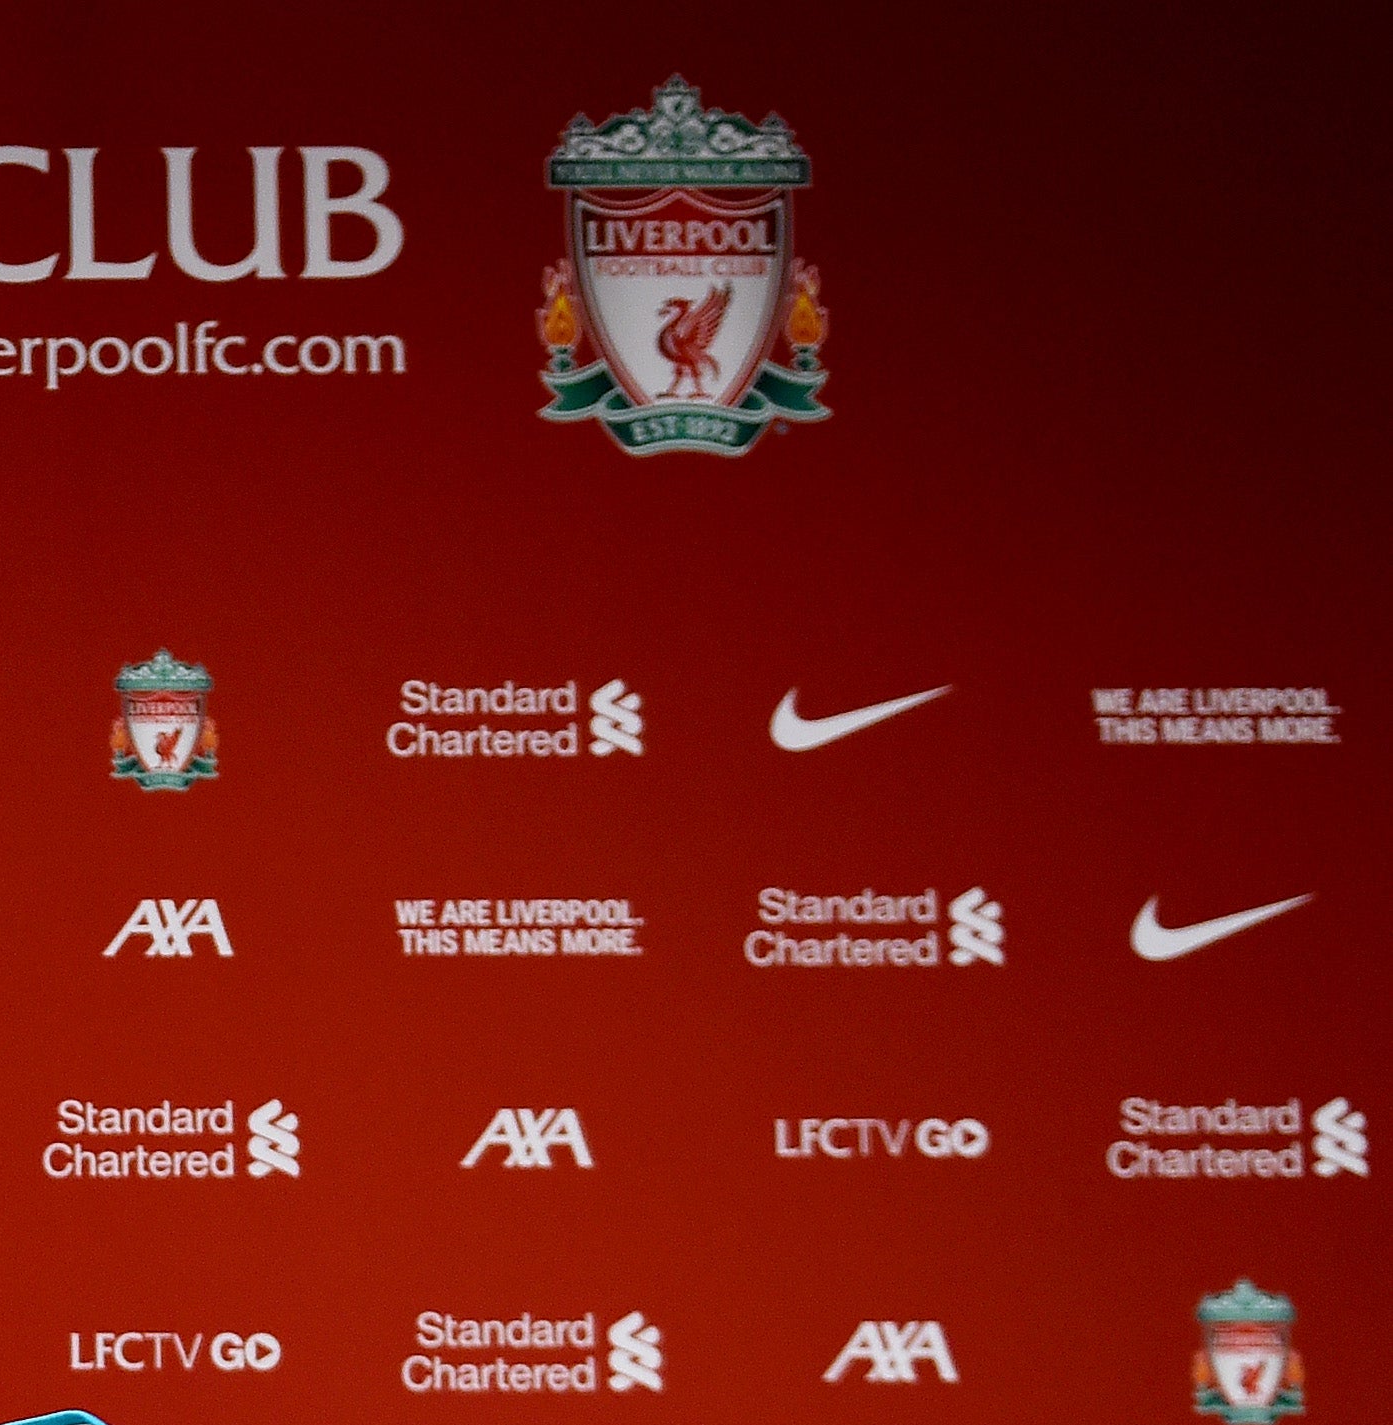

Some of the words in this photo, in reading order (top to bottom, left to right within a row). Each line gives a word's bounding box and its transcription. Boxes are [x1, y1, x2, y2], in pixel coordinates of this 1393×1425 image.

[585, 220, 776, 251] LIVERPOOL
[401, 680, 577, 715] Standard
[386, 722, 578, 757] Chartered
[759, 888, 938, 924] Standard
[102, 899, 234, 958] AXA
[744, 930, 940, 967] Chartered
[58, 1099, 234, 1135] Standard
[1121, 1097, 1301, 1135] Standard
[42, 1143, 235, 1178] Chartered
[1106, 1141, 1304, 1178] Chartered
[416, 1311, 596, 1349] Standard
[401, 1355, 597, 1393] Chartered
